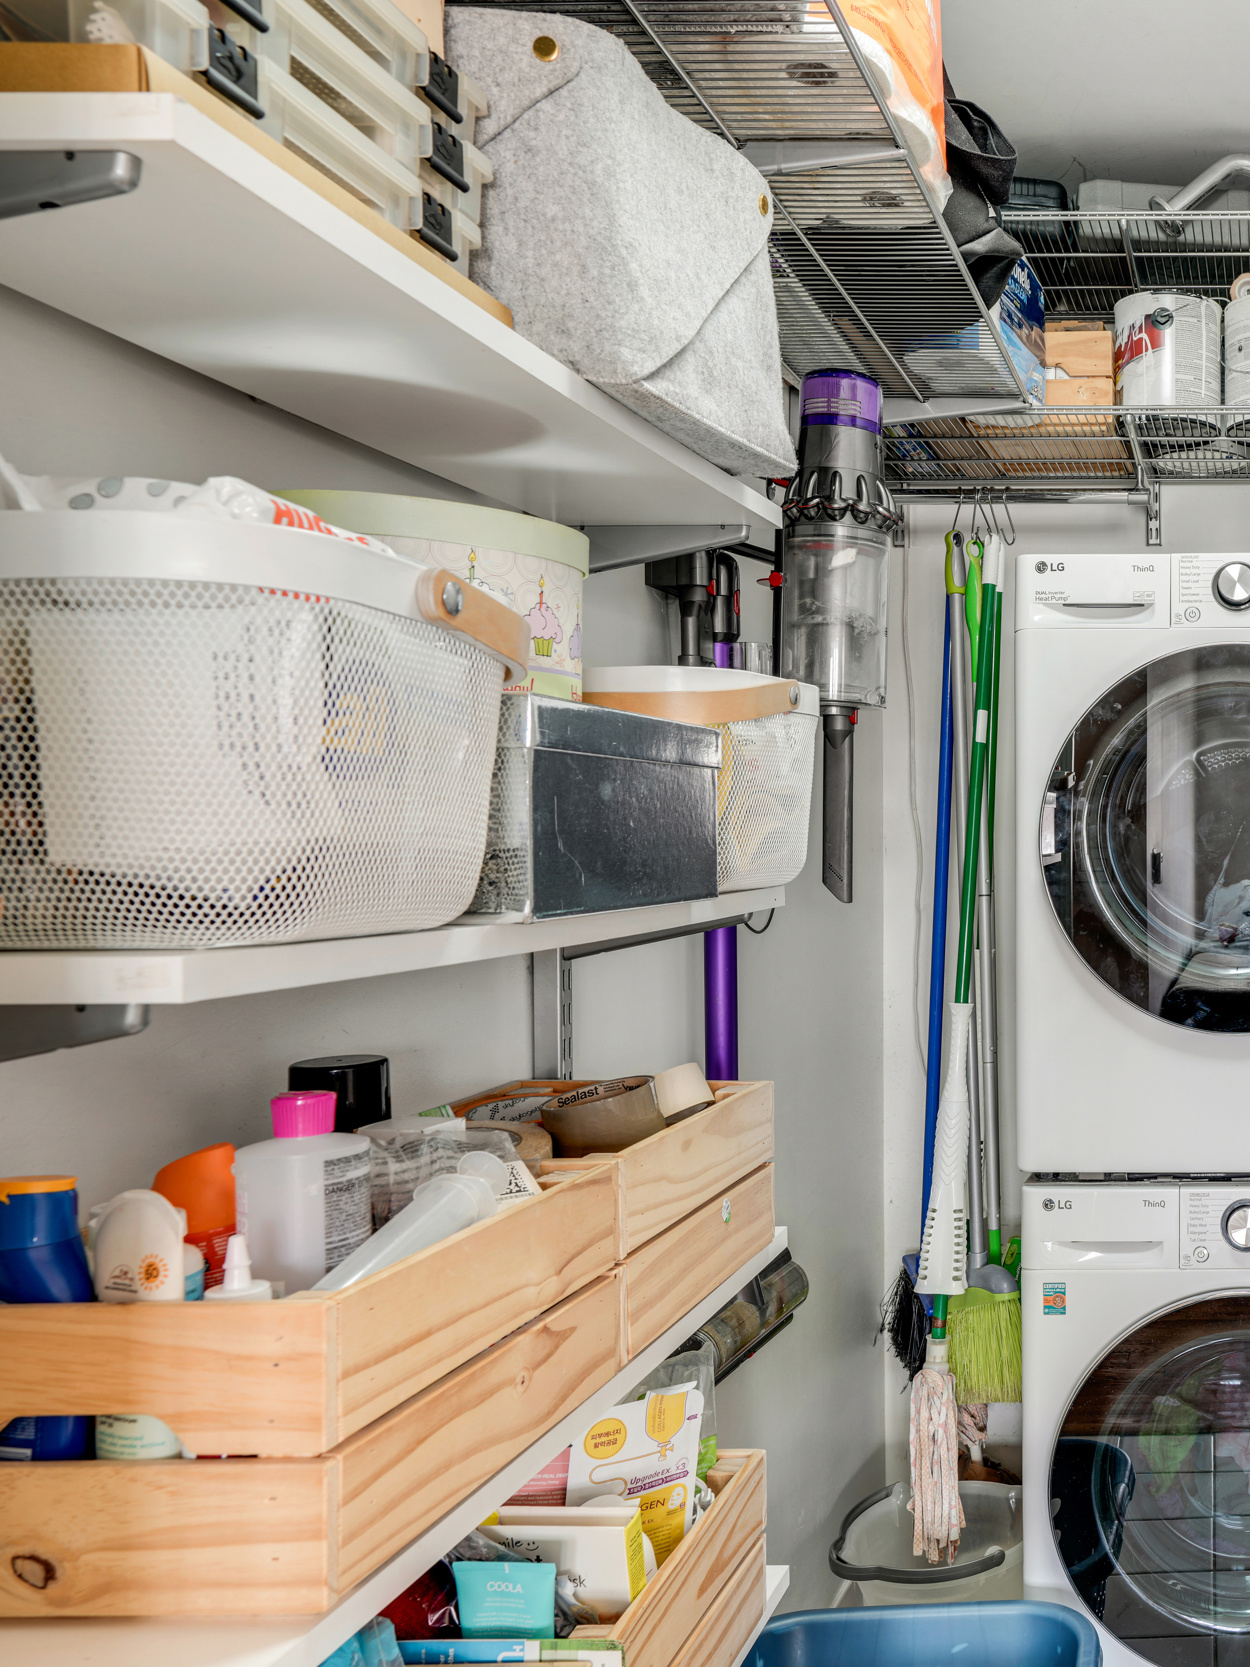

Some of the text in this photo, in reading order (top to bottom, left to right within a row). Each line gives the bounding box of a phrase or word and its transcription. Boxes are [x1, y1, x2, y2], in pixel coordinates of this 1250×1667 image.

[1050, 562, 1155, 573] LG ThinQ
[557, 1085, 600, 1109] Sealast
[1057, 1199, 1166, 1210] LG ThinQ
[590, 1428, 622, 1441] 피부에너지
[629, 1470, 660, 1486] Upgrade
[487, 1581, 522, 1594] COOLA
